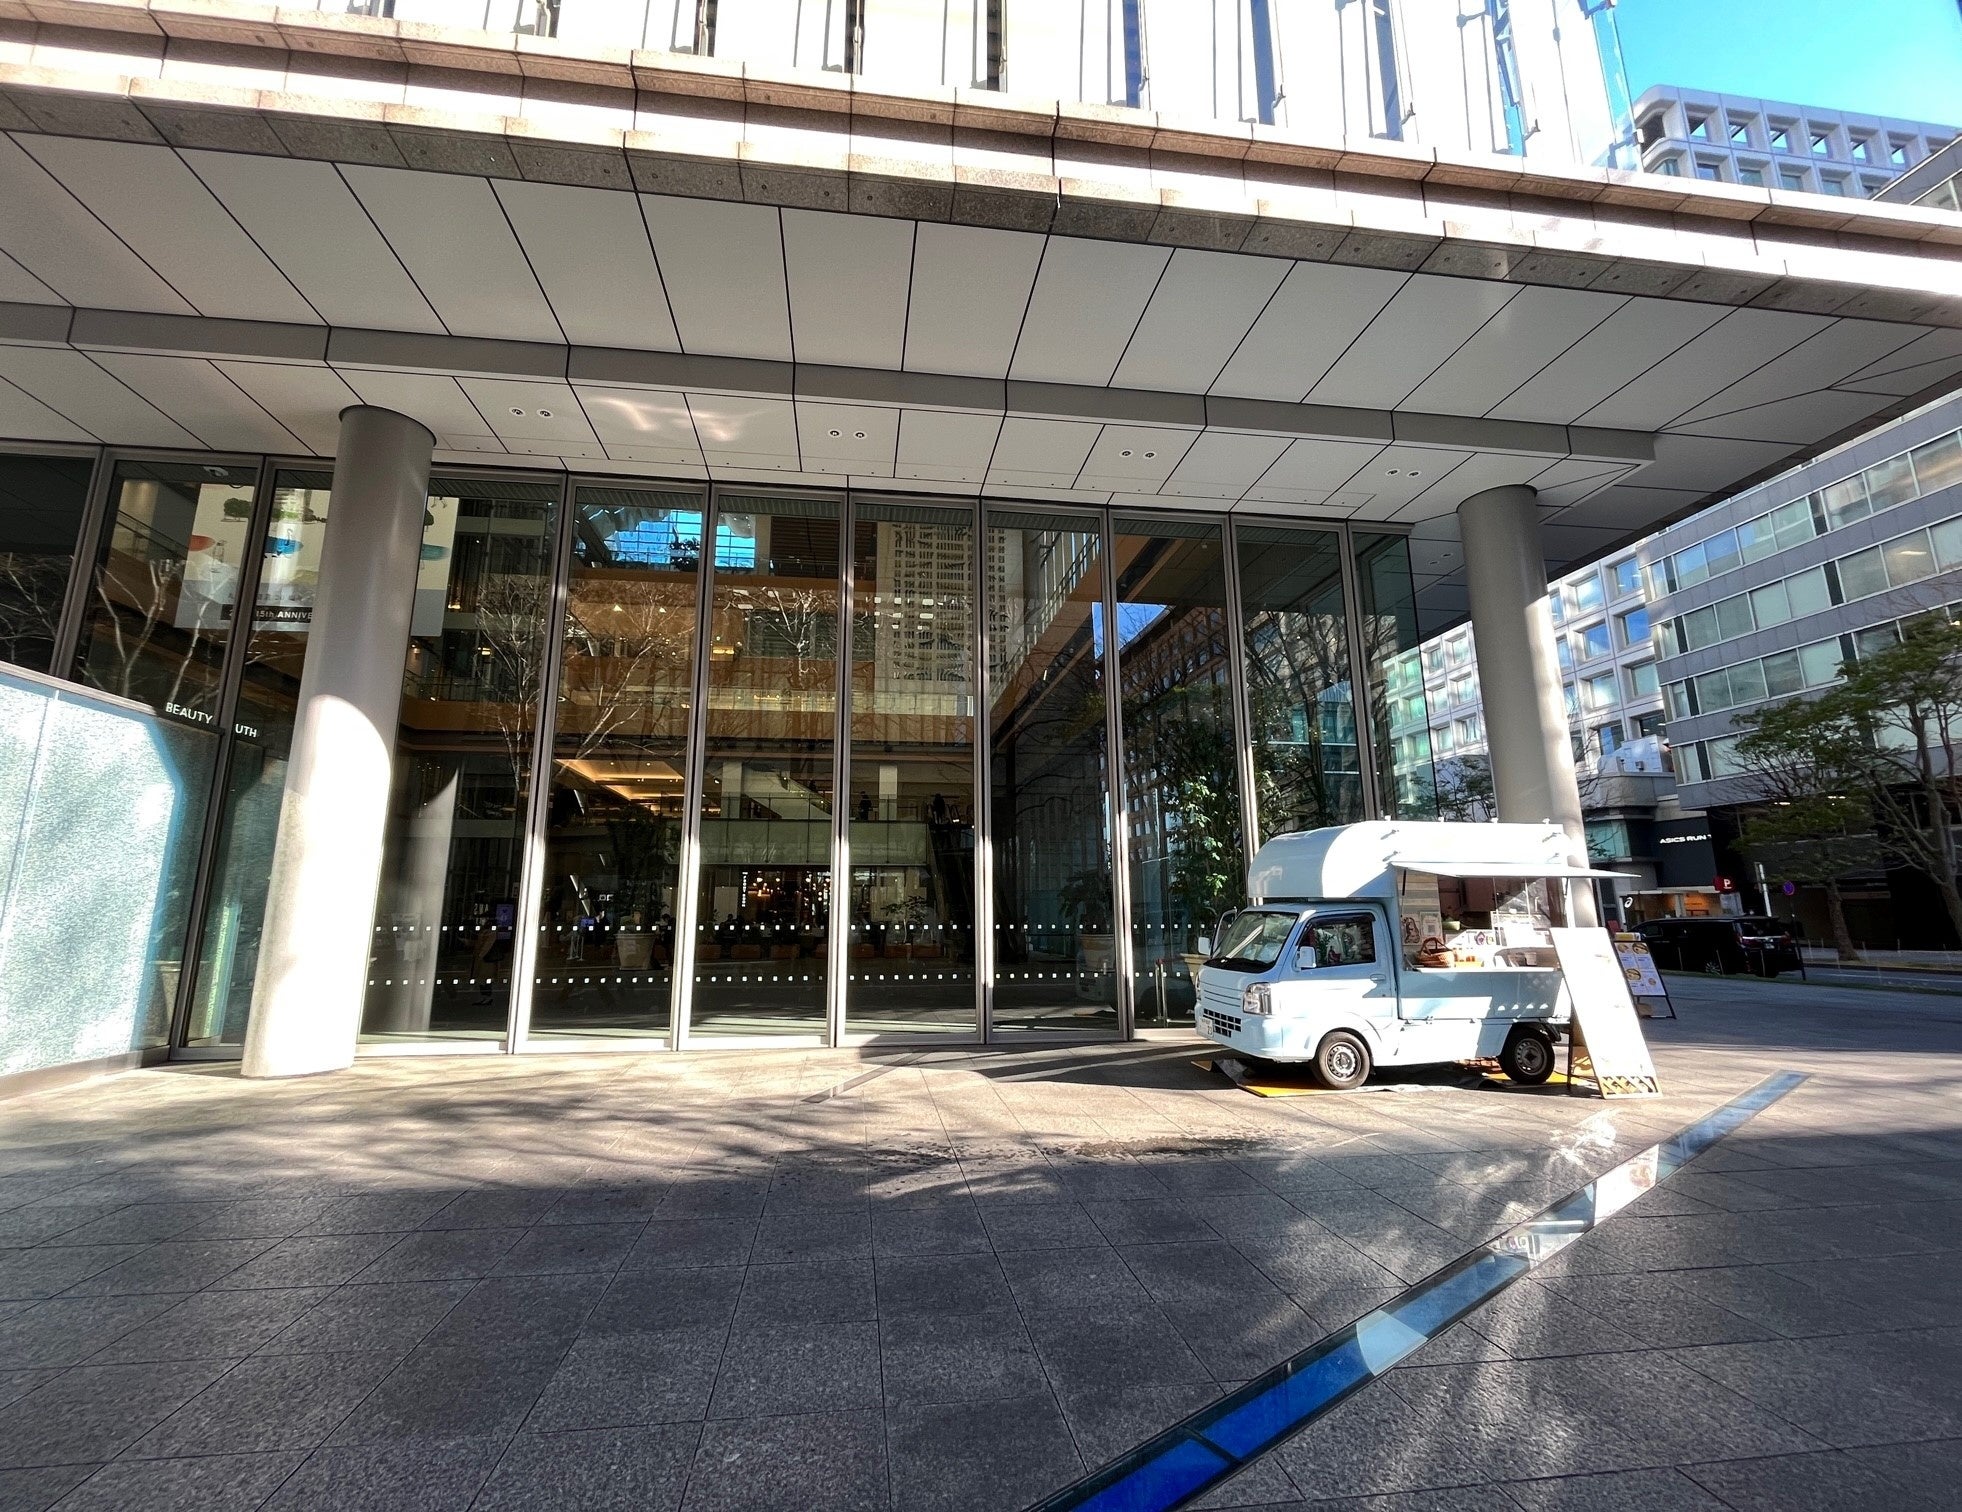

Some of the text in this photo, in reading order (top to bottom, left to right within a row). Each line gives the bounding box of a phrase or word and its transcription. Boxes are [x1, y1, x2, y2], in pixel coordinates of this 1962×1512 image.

[165, 702, 213, 724] BEAUTY
[1660, 836, 1686, 844] ASICS
[1686, 834, 1707, 842] RUN
